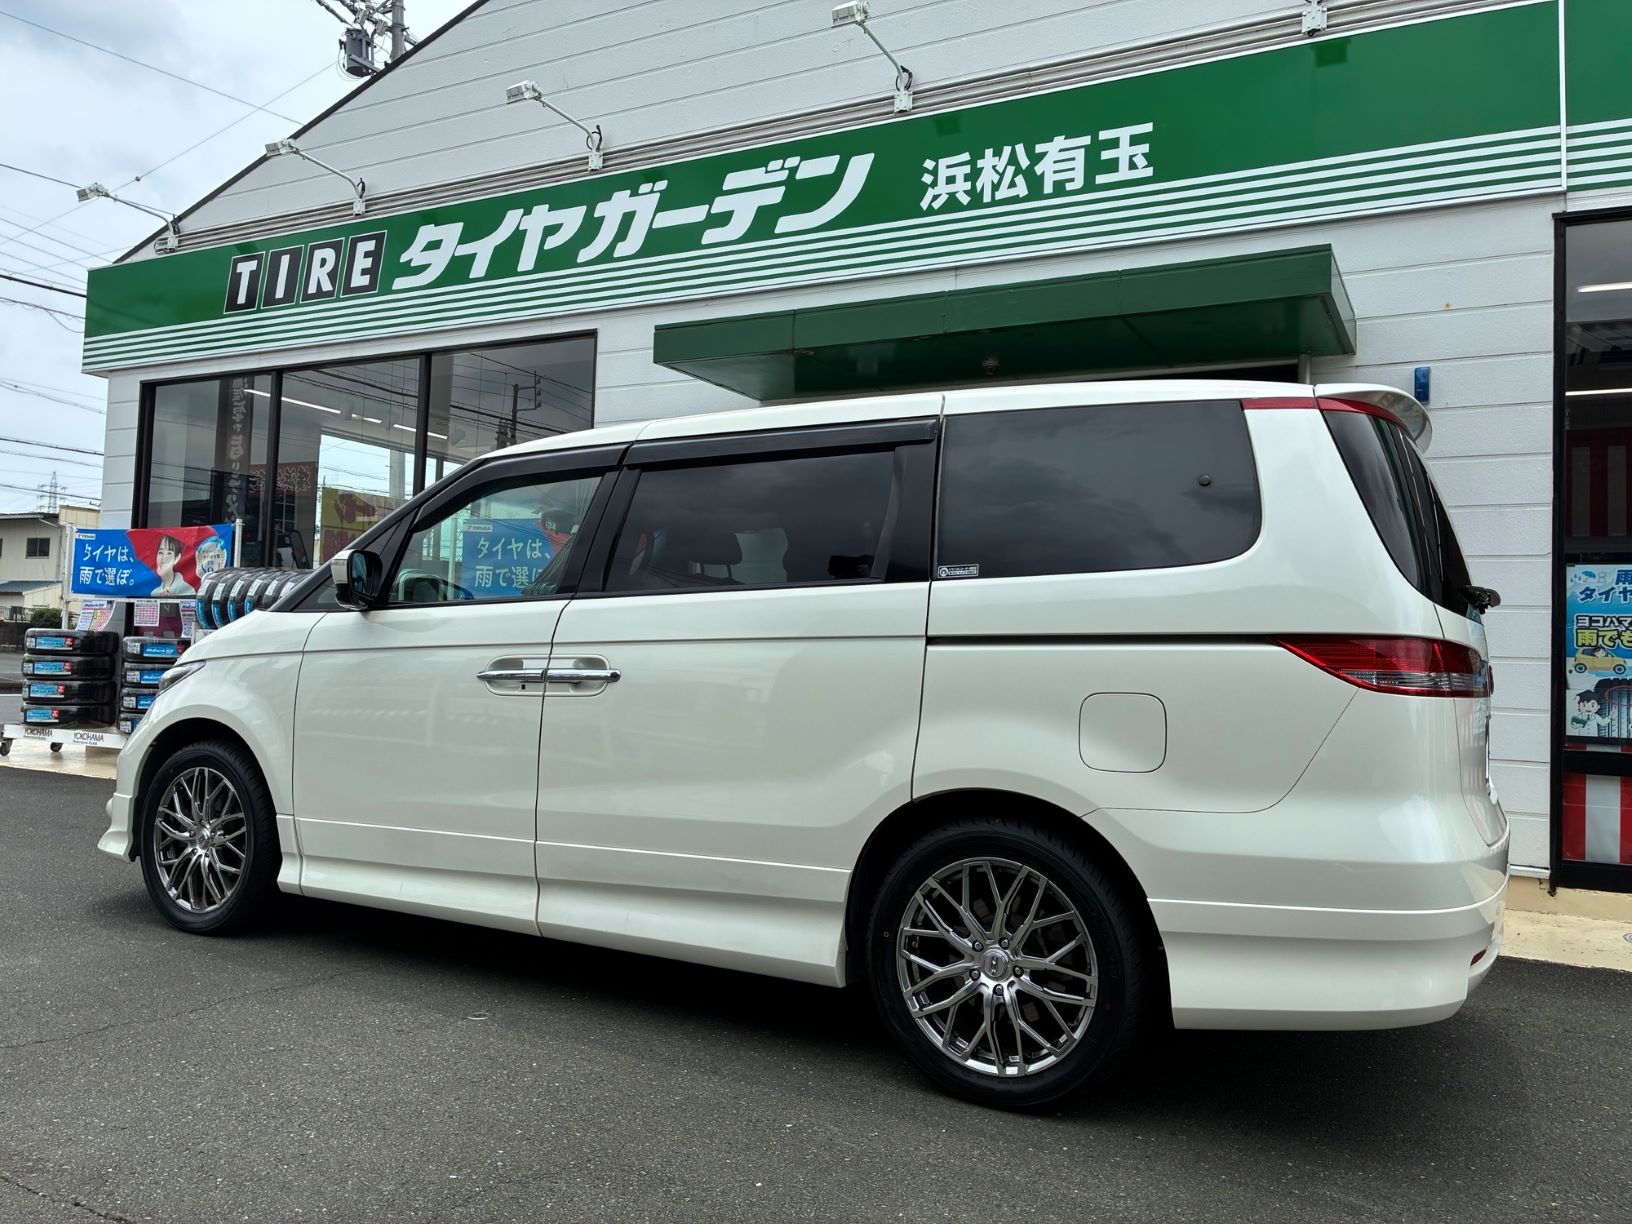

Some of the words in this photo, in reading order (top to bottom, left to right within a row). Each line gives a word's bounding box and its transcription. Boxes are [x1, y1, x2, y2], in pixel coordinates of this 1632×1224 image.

[391, 152, 875, 291] タイヤガーデン
[919, 121, 1154, 211] 浜松有玉
[235, 240, 377, 305] TIRE
[82, 543, 134, 563] タイヤは、
[477, 537, 551, 560] タイヤは、
[73, 732, 104, 742] YOKOHAMA
